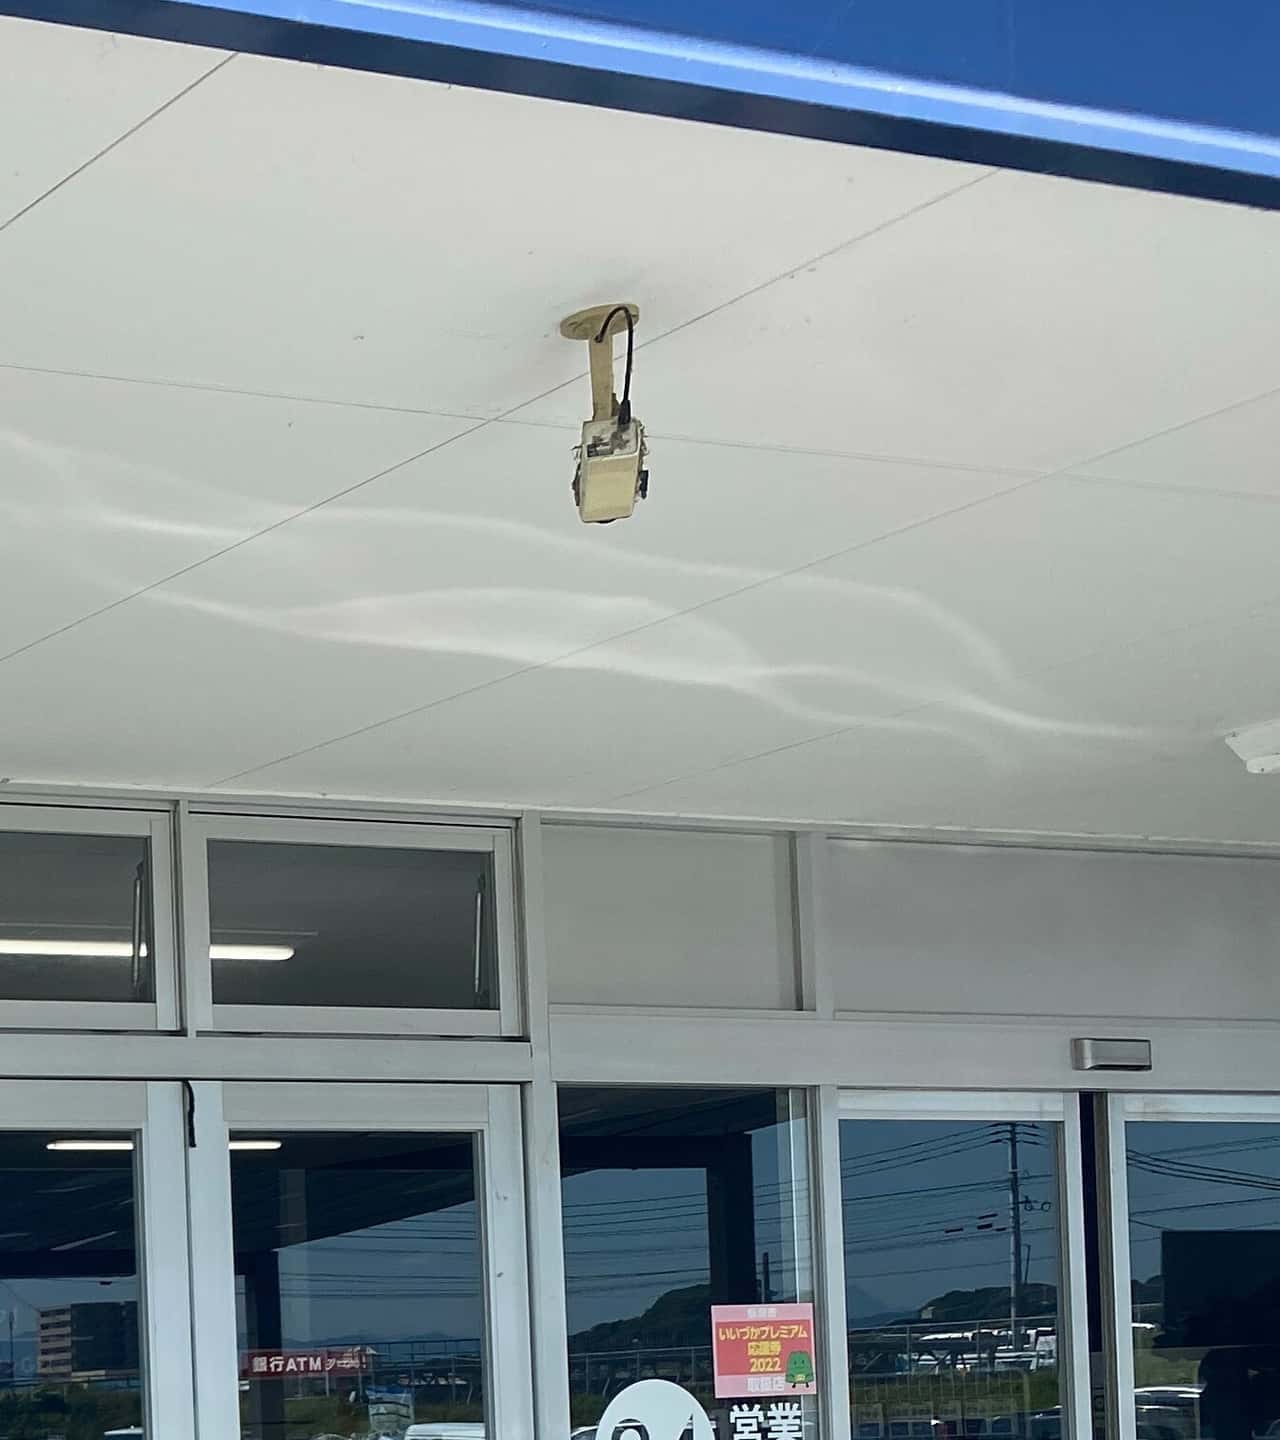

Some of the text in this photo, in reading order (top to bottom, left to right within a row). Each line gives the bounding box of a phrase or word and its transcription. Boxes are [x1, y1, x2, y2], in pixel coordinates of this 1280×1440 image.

[719, 1325, 808, 1340] いいづかプレミアム
[750, 1358, 782, 1373] 2022
